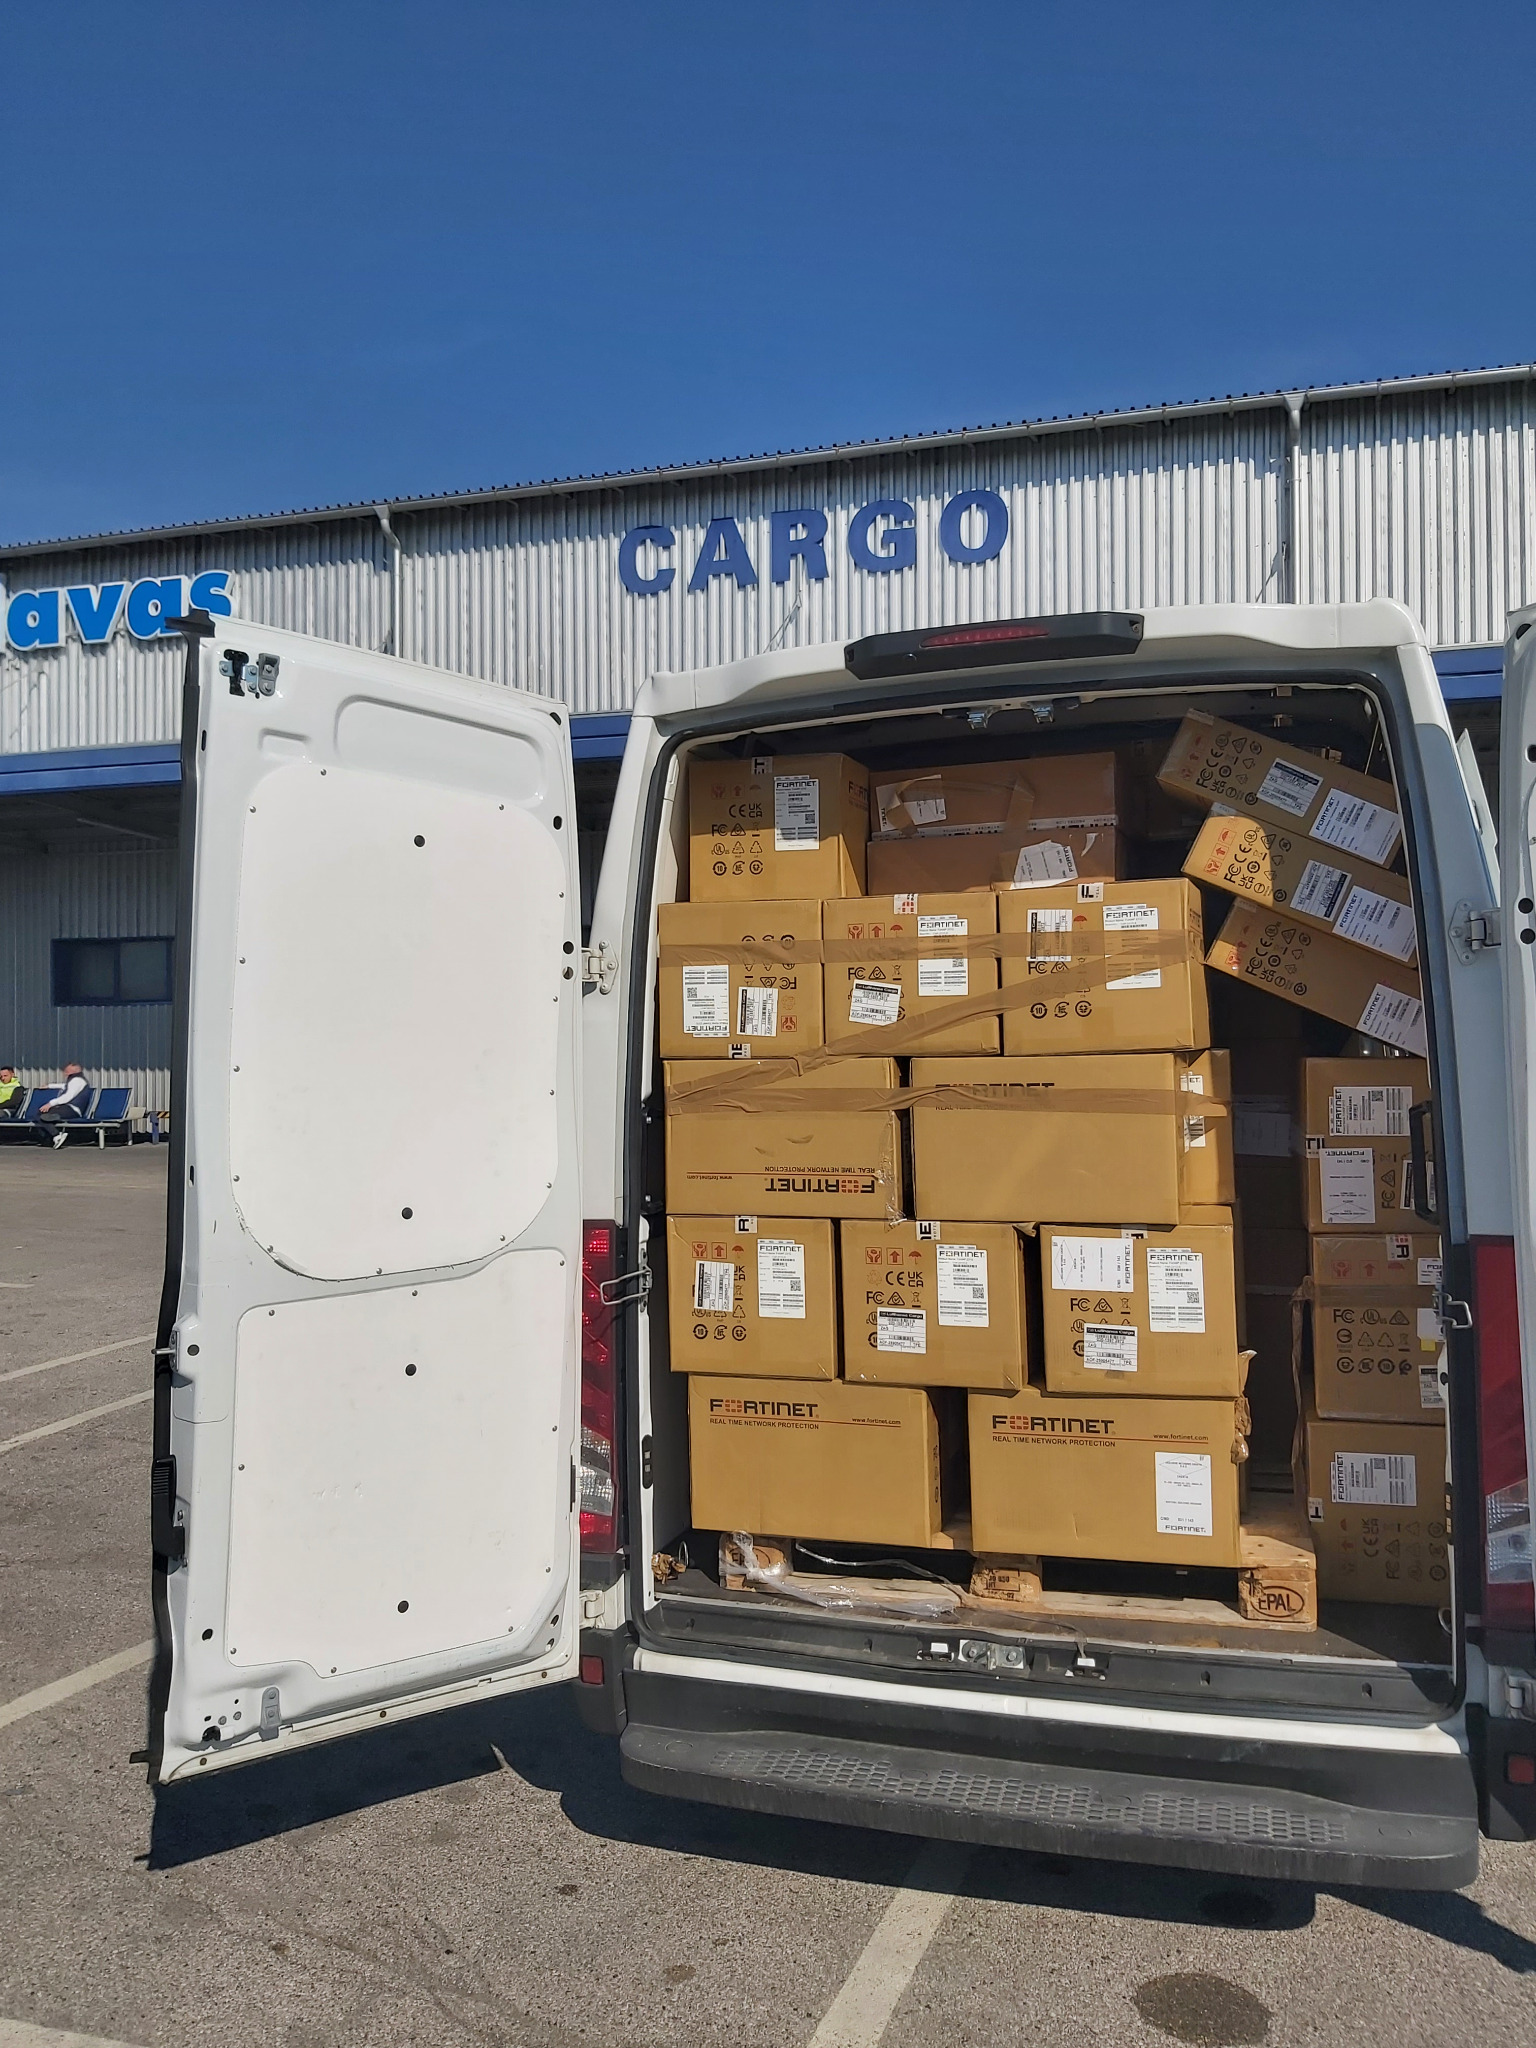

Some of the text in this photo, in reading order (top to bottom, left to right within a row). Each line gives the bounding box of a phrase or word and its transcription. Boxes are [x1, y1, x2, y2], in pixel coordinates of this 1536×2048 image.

[618, 489, 1010, 596] CARGO
[0, 570, 236, 652] avas
[776, 780, 817, 789] FORTINET
[1315, 796, 1335, 831] FORTINET
[1106, 910, 1155, 919] FORTINET
[765, 1178, 875, 1194] FORTINET
[939, 1250, 985, 1258] FORTINET
[908, 1271, 923, 1279] UK
[710, 1398, 818, 1418] FORTINET
[744, 1420, 776, 1428] NETWORK
[777, 1422, 819, 1430] PROTECTION
[852, 1417, 901, 1425] www.fortinet.com
[992, 1414, 1115, 1435] FORTINET
[992, 1435, 1116, 1448] REAL TIME NETWORK PROTECTION
[1153, 1433, 1209, 1442] www.fortinet.com
[1165, 1525, 1204, 1533] FORTINET
[1258, 1593, 1297, 1612] EPAL
